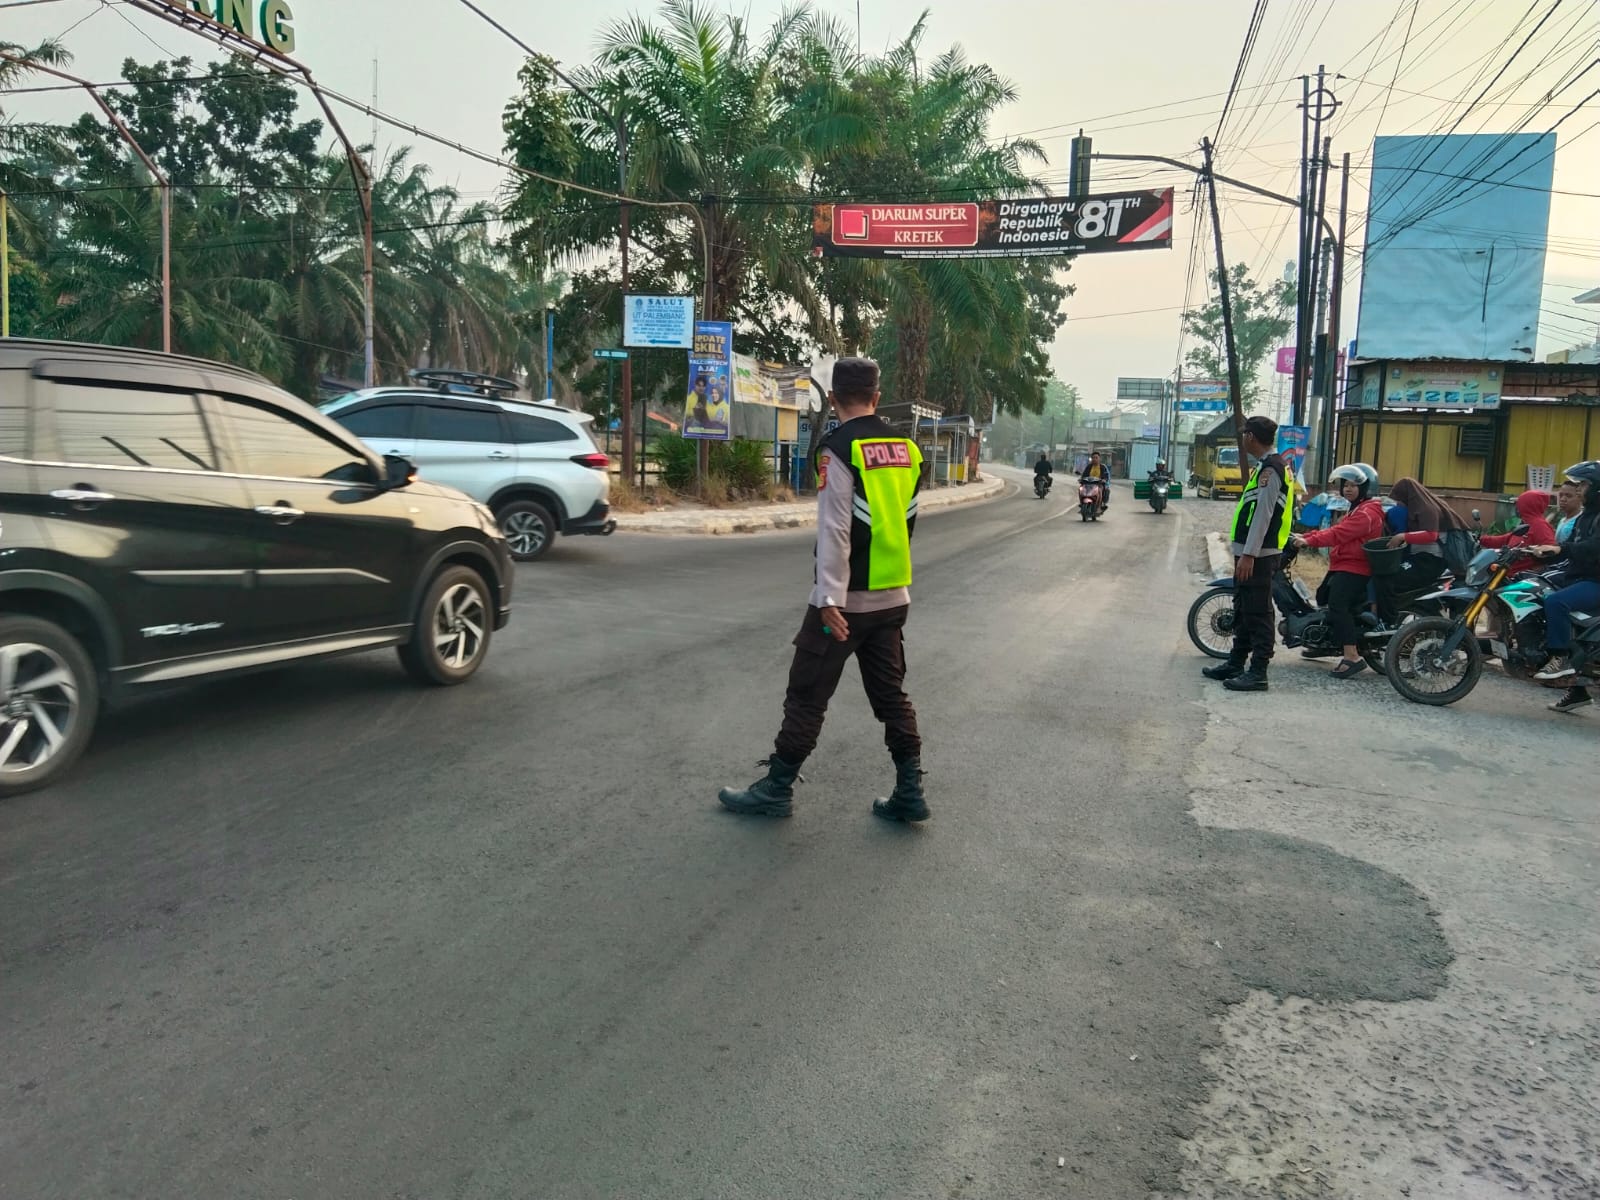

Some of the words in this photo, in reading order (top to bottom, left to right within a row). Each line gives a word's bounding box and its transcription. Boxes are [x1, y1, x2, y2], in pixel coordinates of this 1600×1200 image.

[872, 208, 923, 222] DJARUM
[925, 208, 967, 220] SUPER
[999, 201, 1076, 218] Dirgahayu
[999, 215, 1063, 231] Republik
[894, 231, 944, 243] KRETEK
[998, 228, 1070, 243] Indonesia
[648, 298, 684, 306] SALUT
[643, 312, 686, 320] PALEMBANG
[695, 343, 723, 354] SKILL
[864, 444, 910, 466] POLISI
